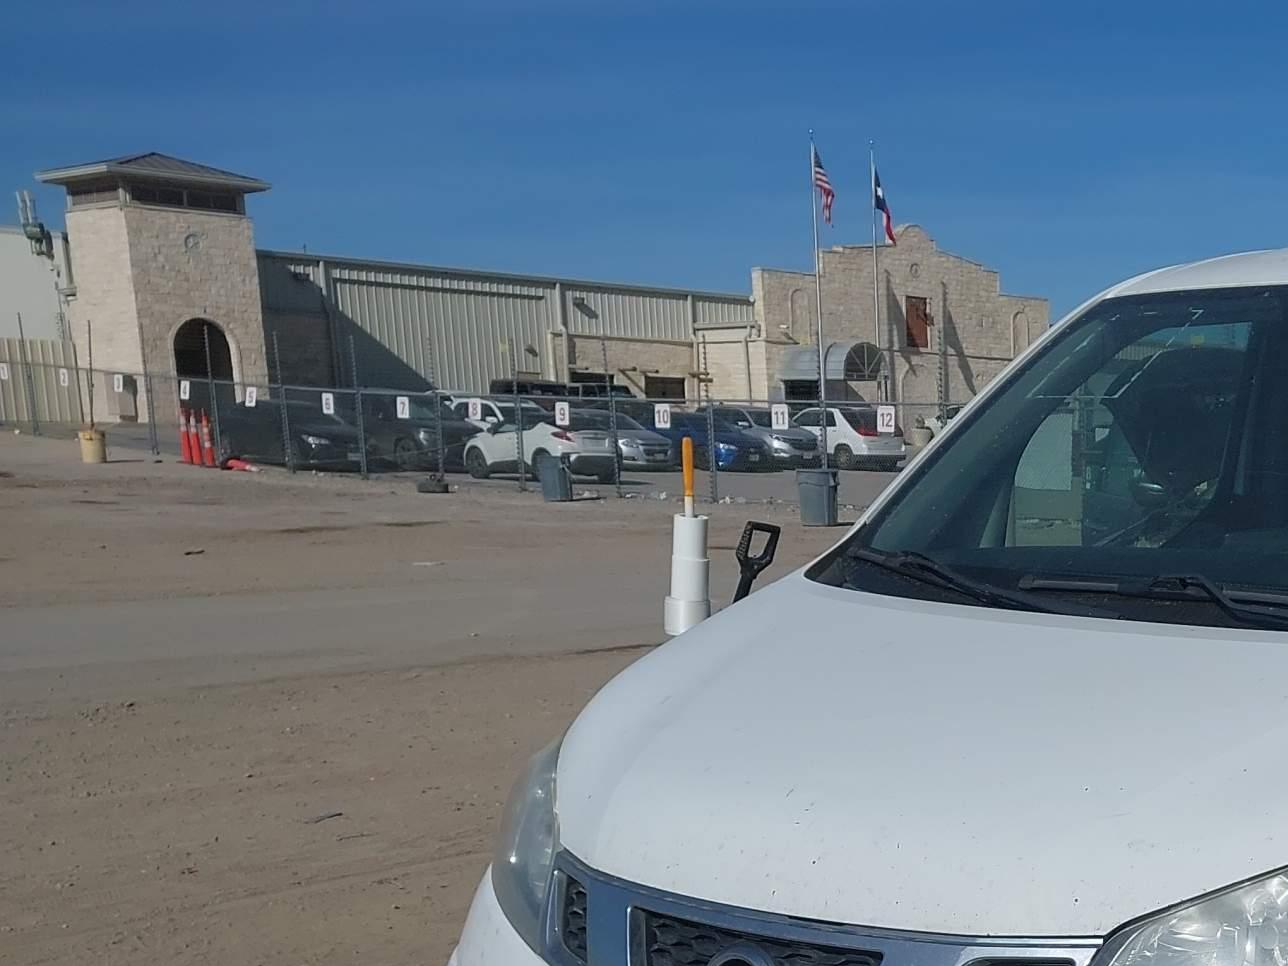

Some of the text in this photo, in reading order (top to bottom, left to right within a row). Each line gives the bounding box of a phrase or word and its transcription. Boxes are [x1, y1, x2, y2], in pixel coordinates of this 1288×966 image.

[656, 408, 668, 424] 10
[774, 408, 786, 424] 11
[880, 412, 893, 428] 12
